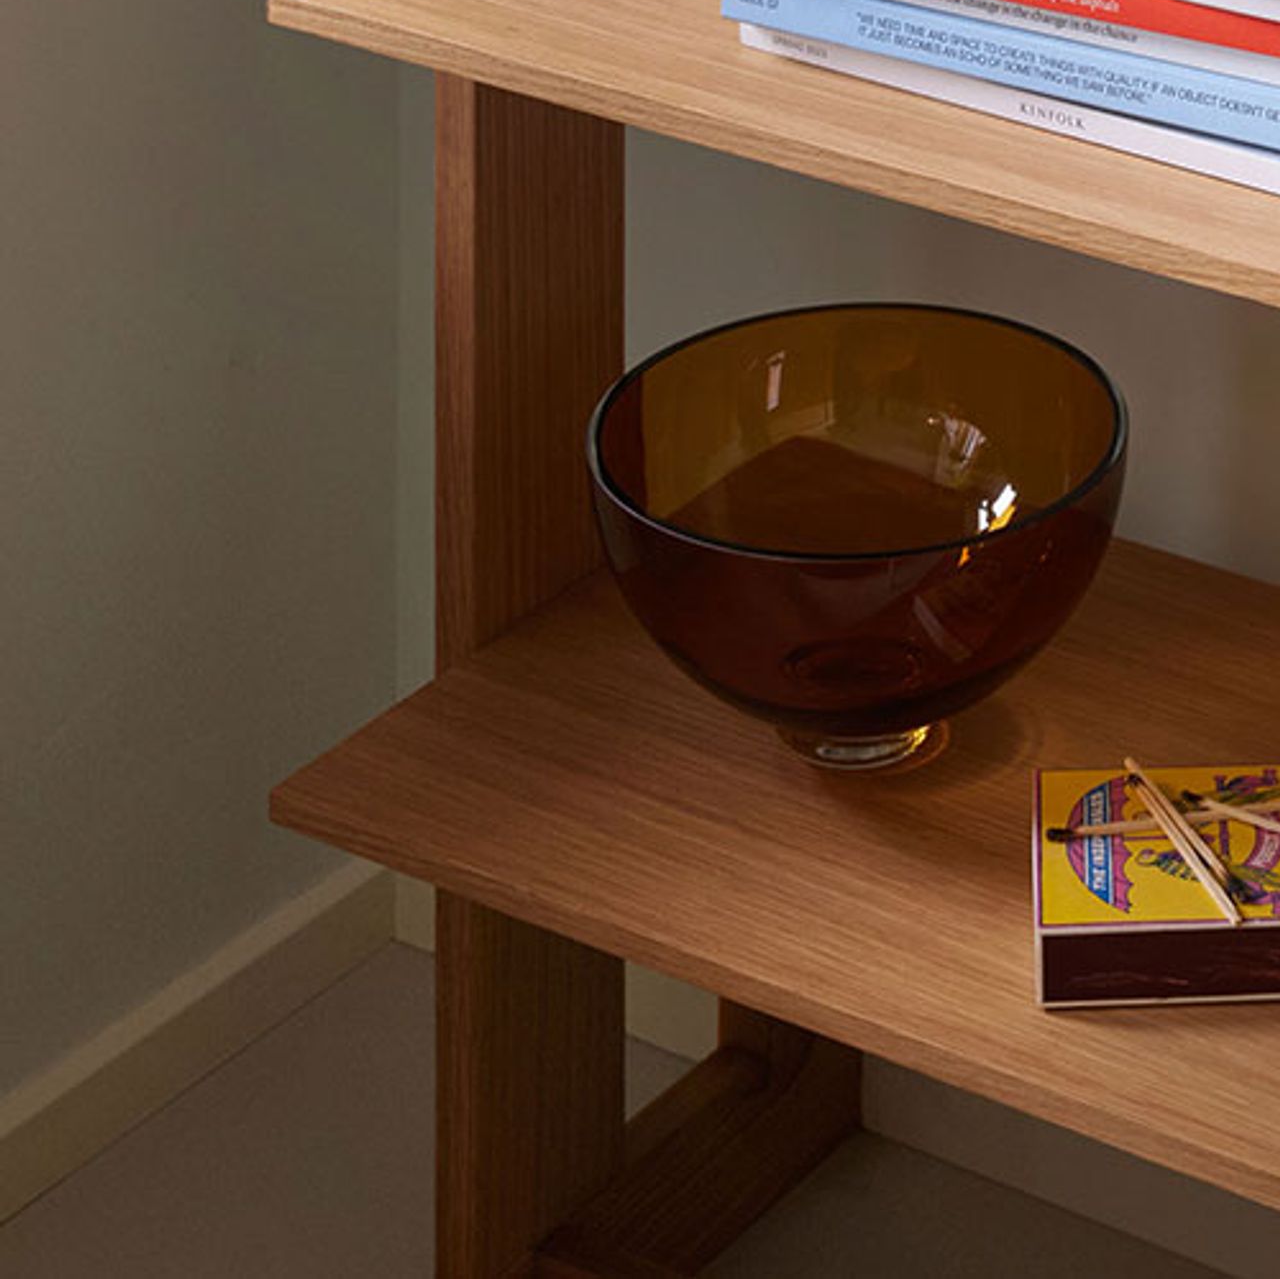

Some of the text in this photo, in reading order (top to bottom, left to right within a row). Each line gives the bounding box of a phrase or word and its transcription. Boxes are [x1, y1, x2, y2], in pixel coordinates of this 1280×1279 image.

[858, 24, 866, 38] IT
[867, 26, 891, 44] JUST
[893, 32, 941, 55] BECOMES
[943, 44, 956, 59] AN
[988, 55, 1001, 69] OF
[1004, 59, 1061, 84] SOMETHING
[1065, 73, 1079, 88] WE
[1082, 77, 1104, 93] SAW
[877, 16, 901, 33] NEED
[903, 22, 924, 38] TIME
[926, 27, 948, 43] AND
[983, 40, 996, 54] TO
[1039, 53, 1073, 72] THINGS
[1077, 62, 1101, 79] WITH
[1150, 79, 1160, 93] IF
[1161, 82, 1175, 96] AN
[1177, 86, 1217, 107] OBJECT
[1020, 103, 1086, 130] KINFOLK
